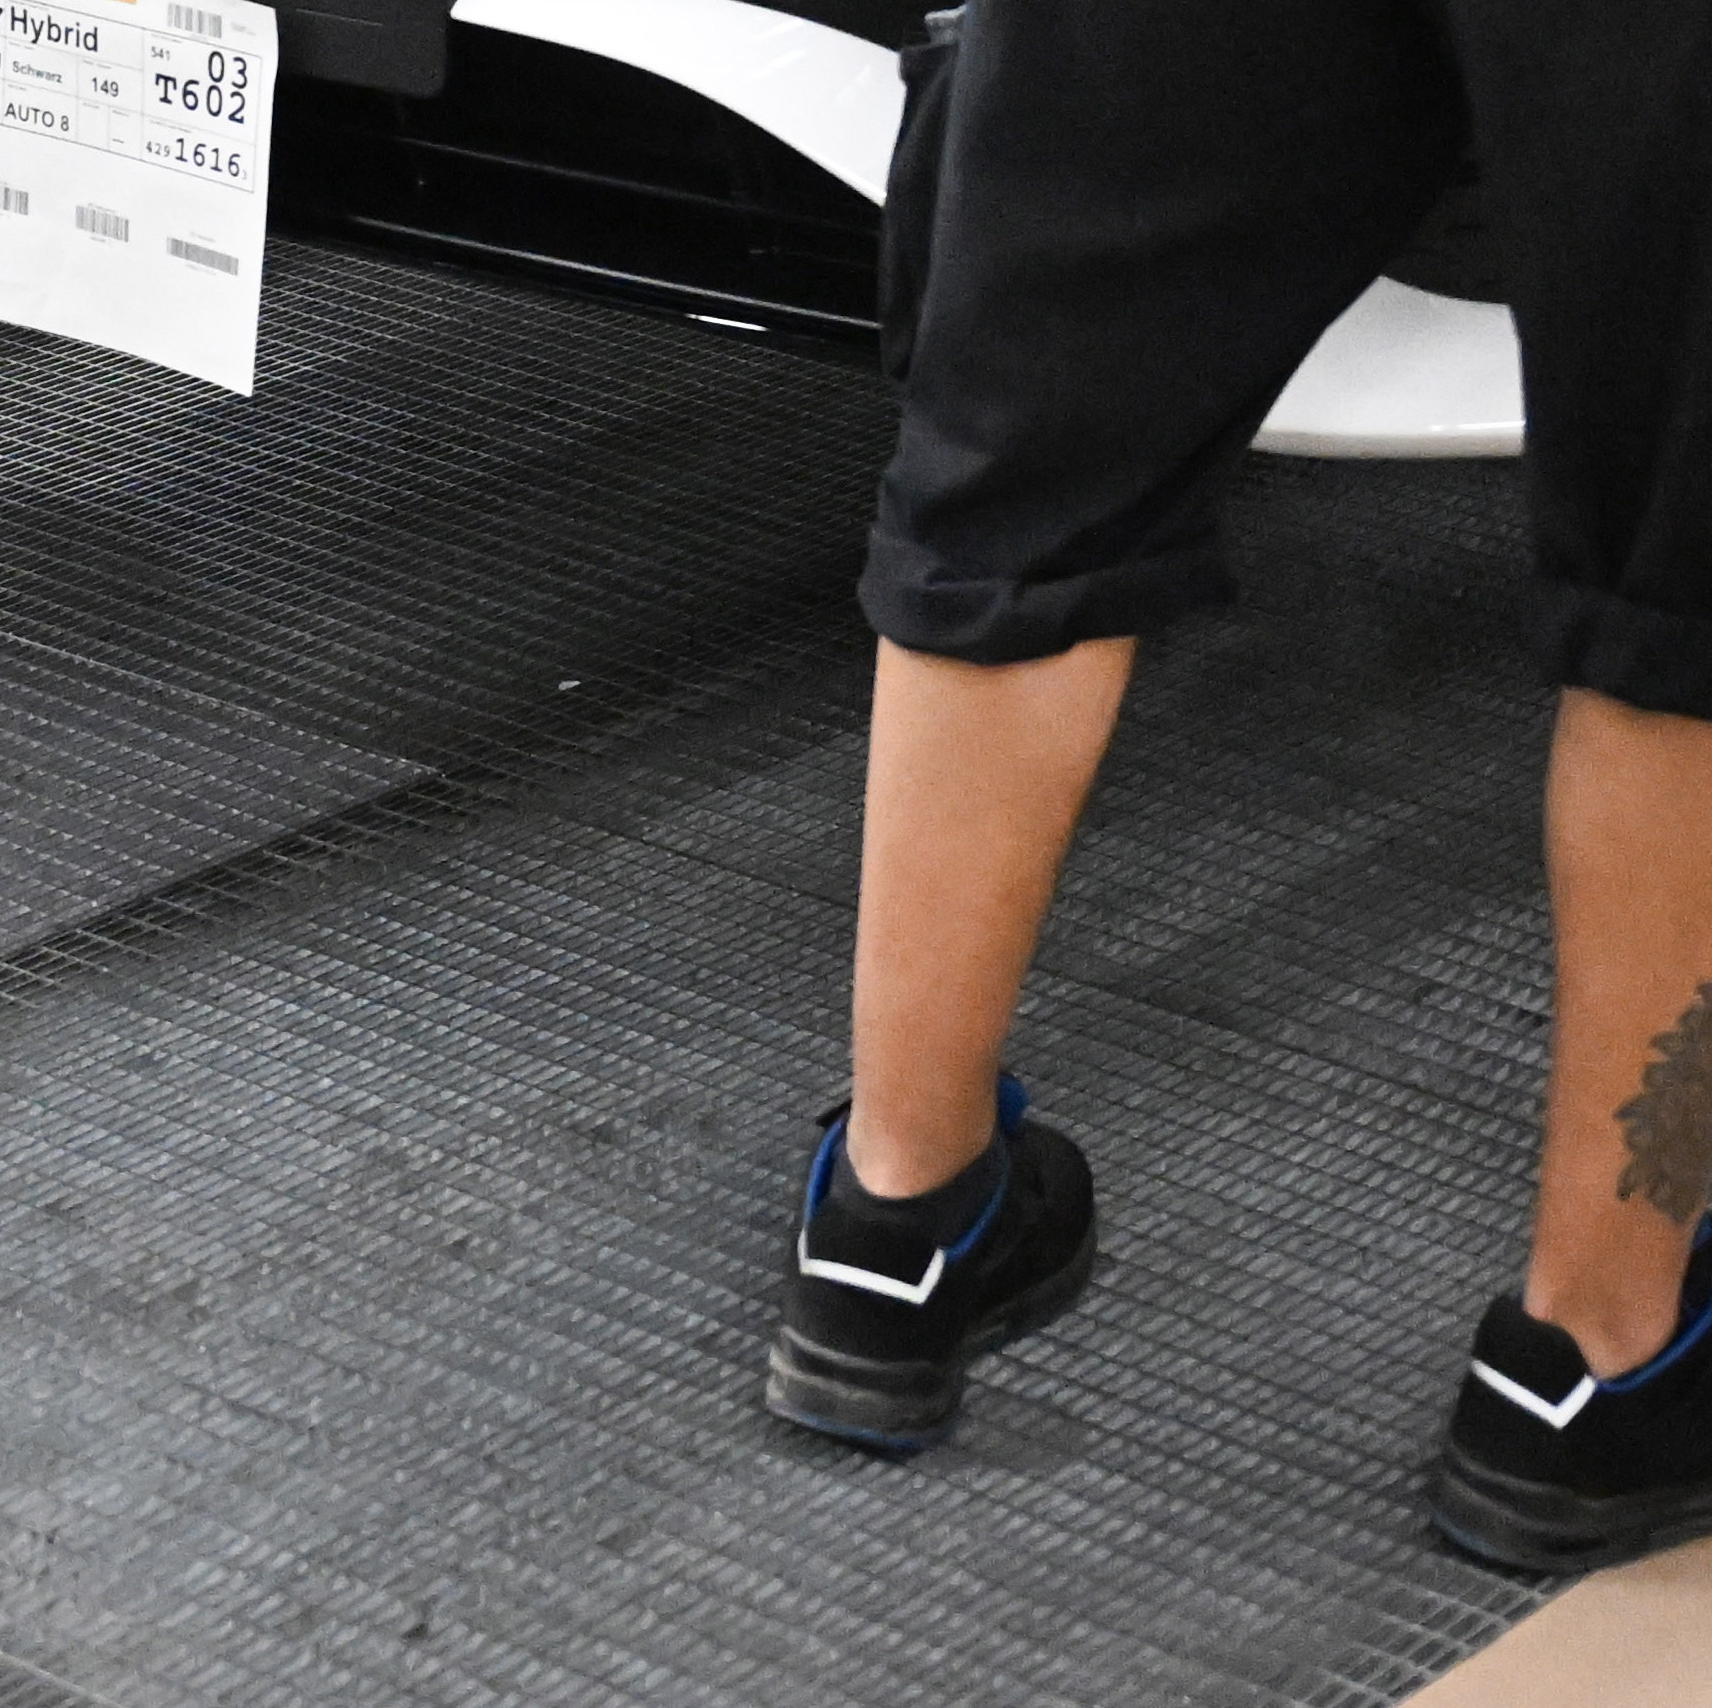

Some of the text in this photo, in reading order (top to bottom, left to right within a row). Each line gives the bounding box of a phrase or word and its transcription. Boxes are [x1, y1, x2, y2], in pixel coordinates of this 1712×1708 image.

[10, 6, 100, 53] Hybrid
[12, 60, 63, 84] Schwarz
[92, 77, 120, 97] 149
[208, 51, 248, 90] 03
[4, 103, 55, 128] AUTO
[60, 115, 70, 132] 8
[155, 72, 247, 124] T602
[174, 137, 240, 178] 1616
